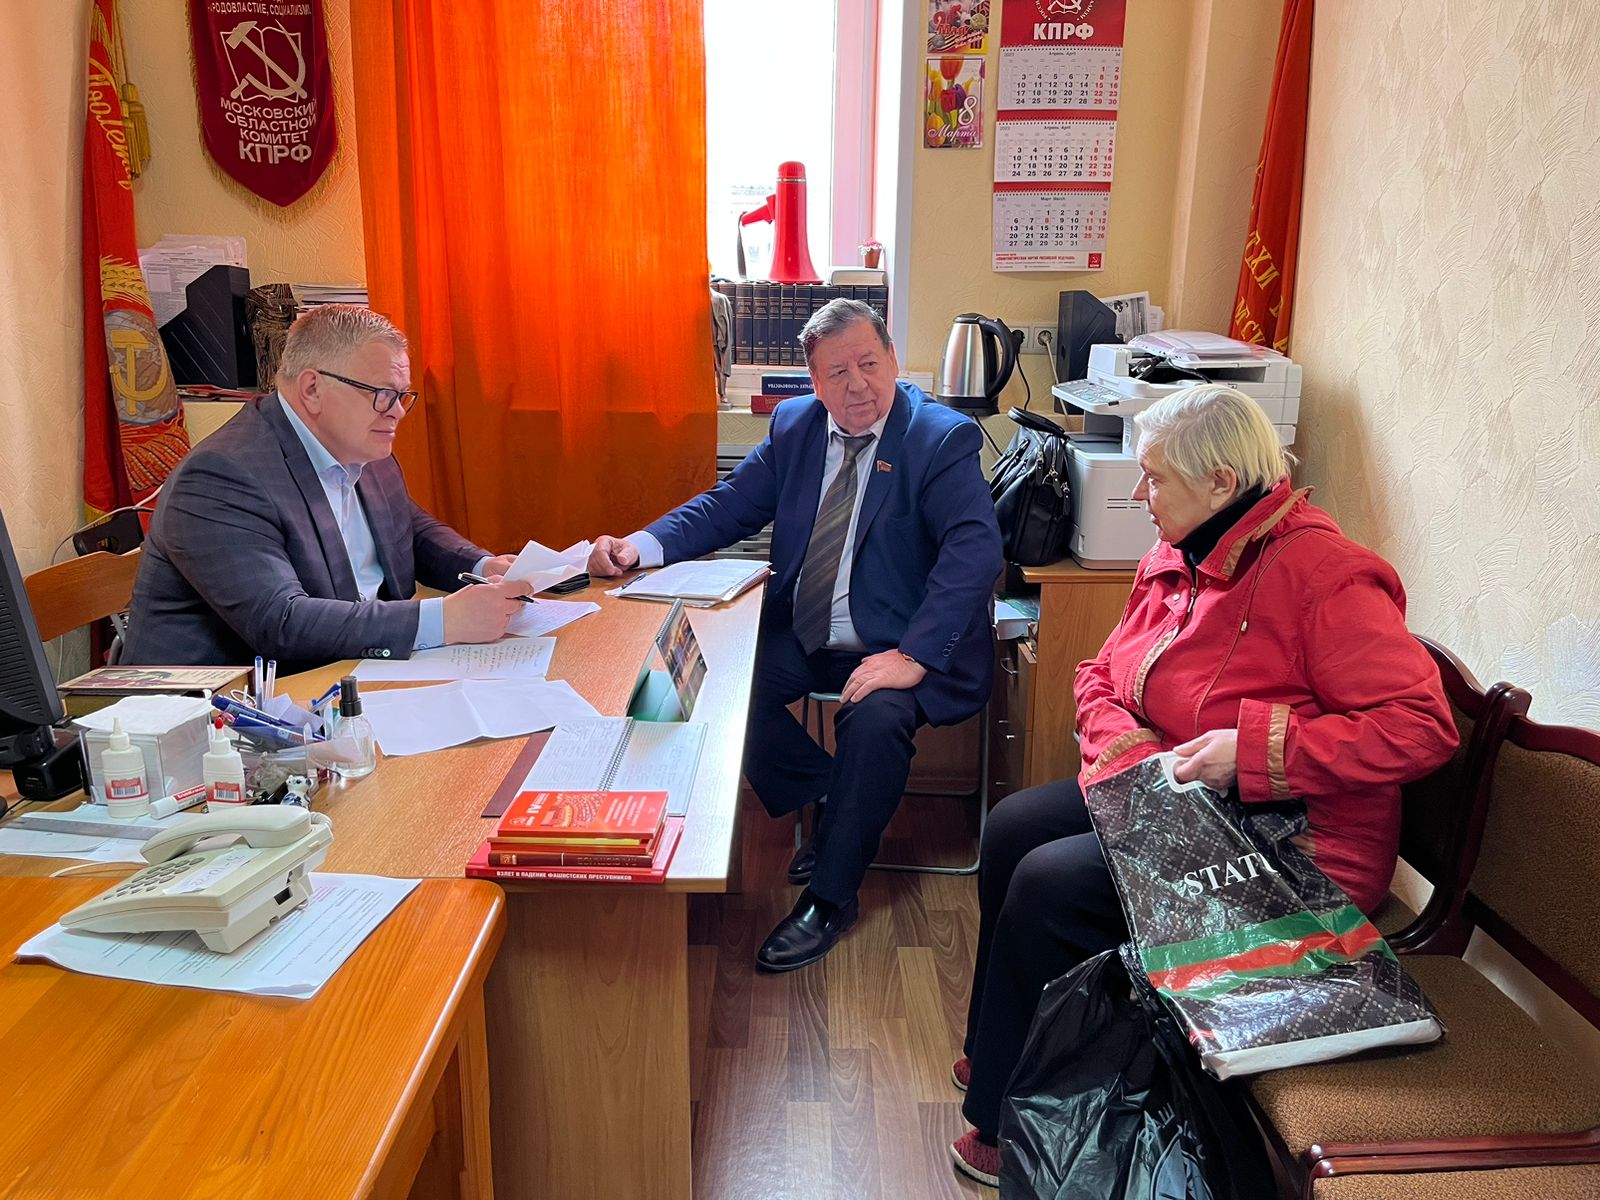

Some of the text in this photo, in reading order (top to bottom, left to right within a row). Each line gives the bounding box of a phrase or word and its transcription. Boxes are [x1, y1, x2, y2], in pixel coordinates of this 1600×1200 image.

[1034, 23, 1094, 40] КПРФ
[221, 97, 317, 118] МОСКОВСКИЙ
[958, 96, 977, 126] 8
[240, 128, 308, 144] КОМИТЕТ
[928, 124, 976, 142] Марта
[239, 140, 312, 164] КПРФ
